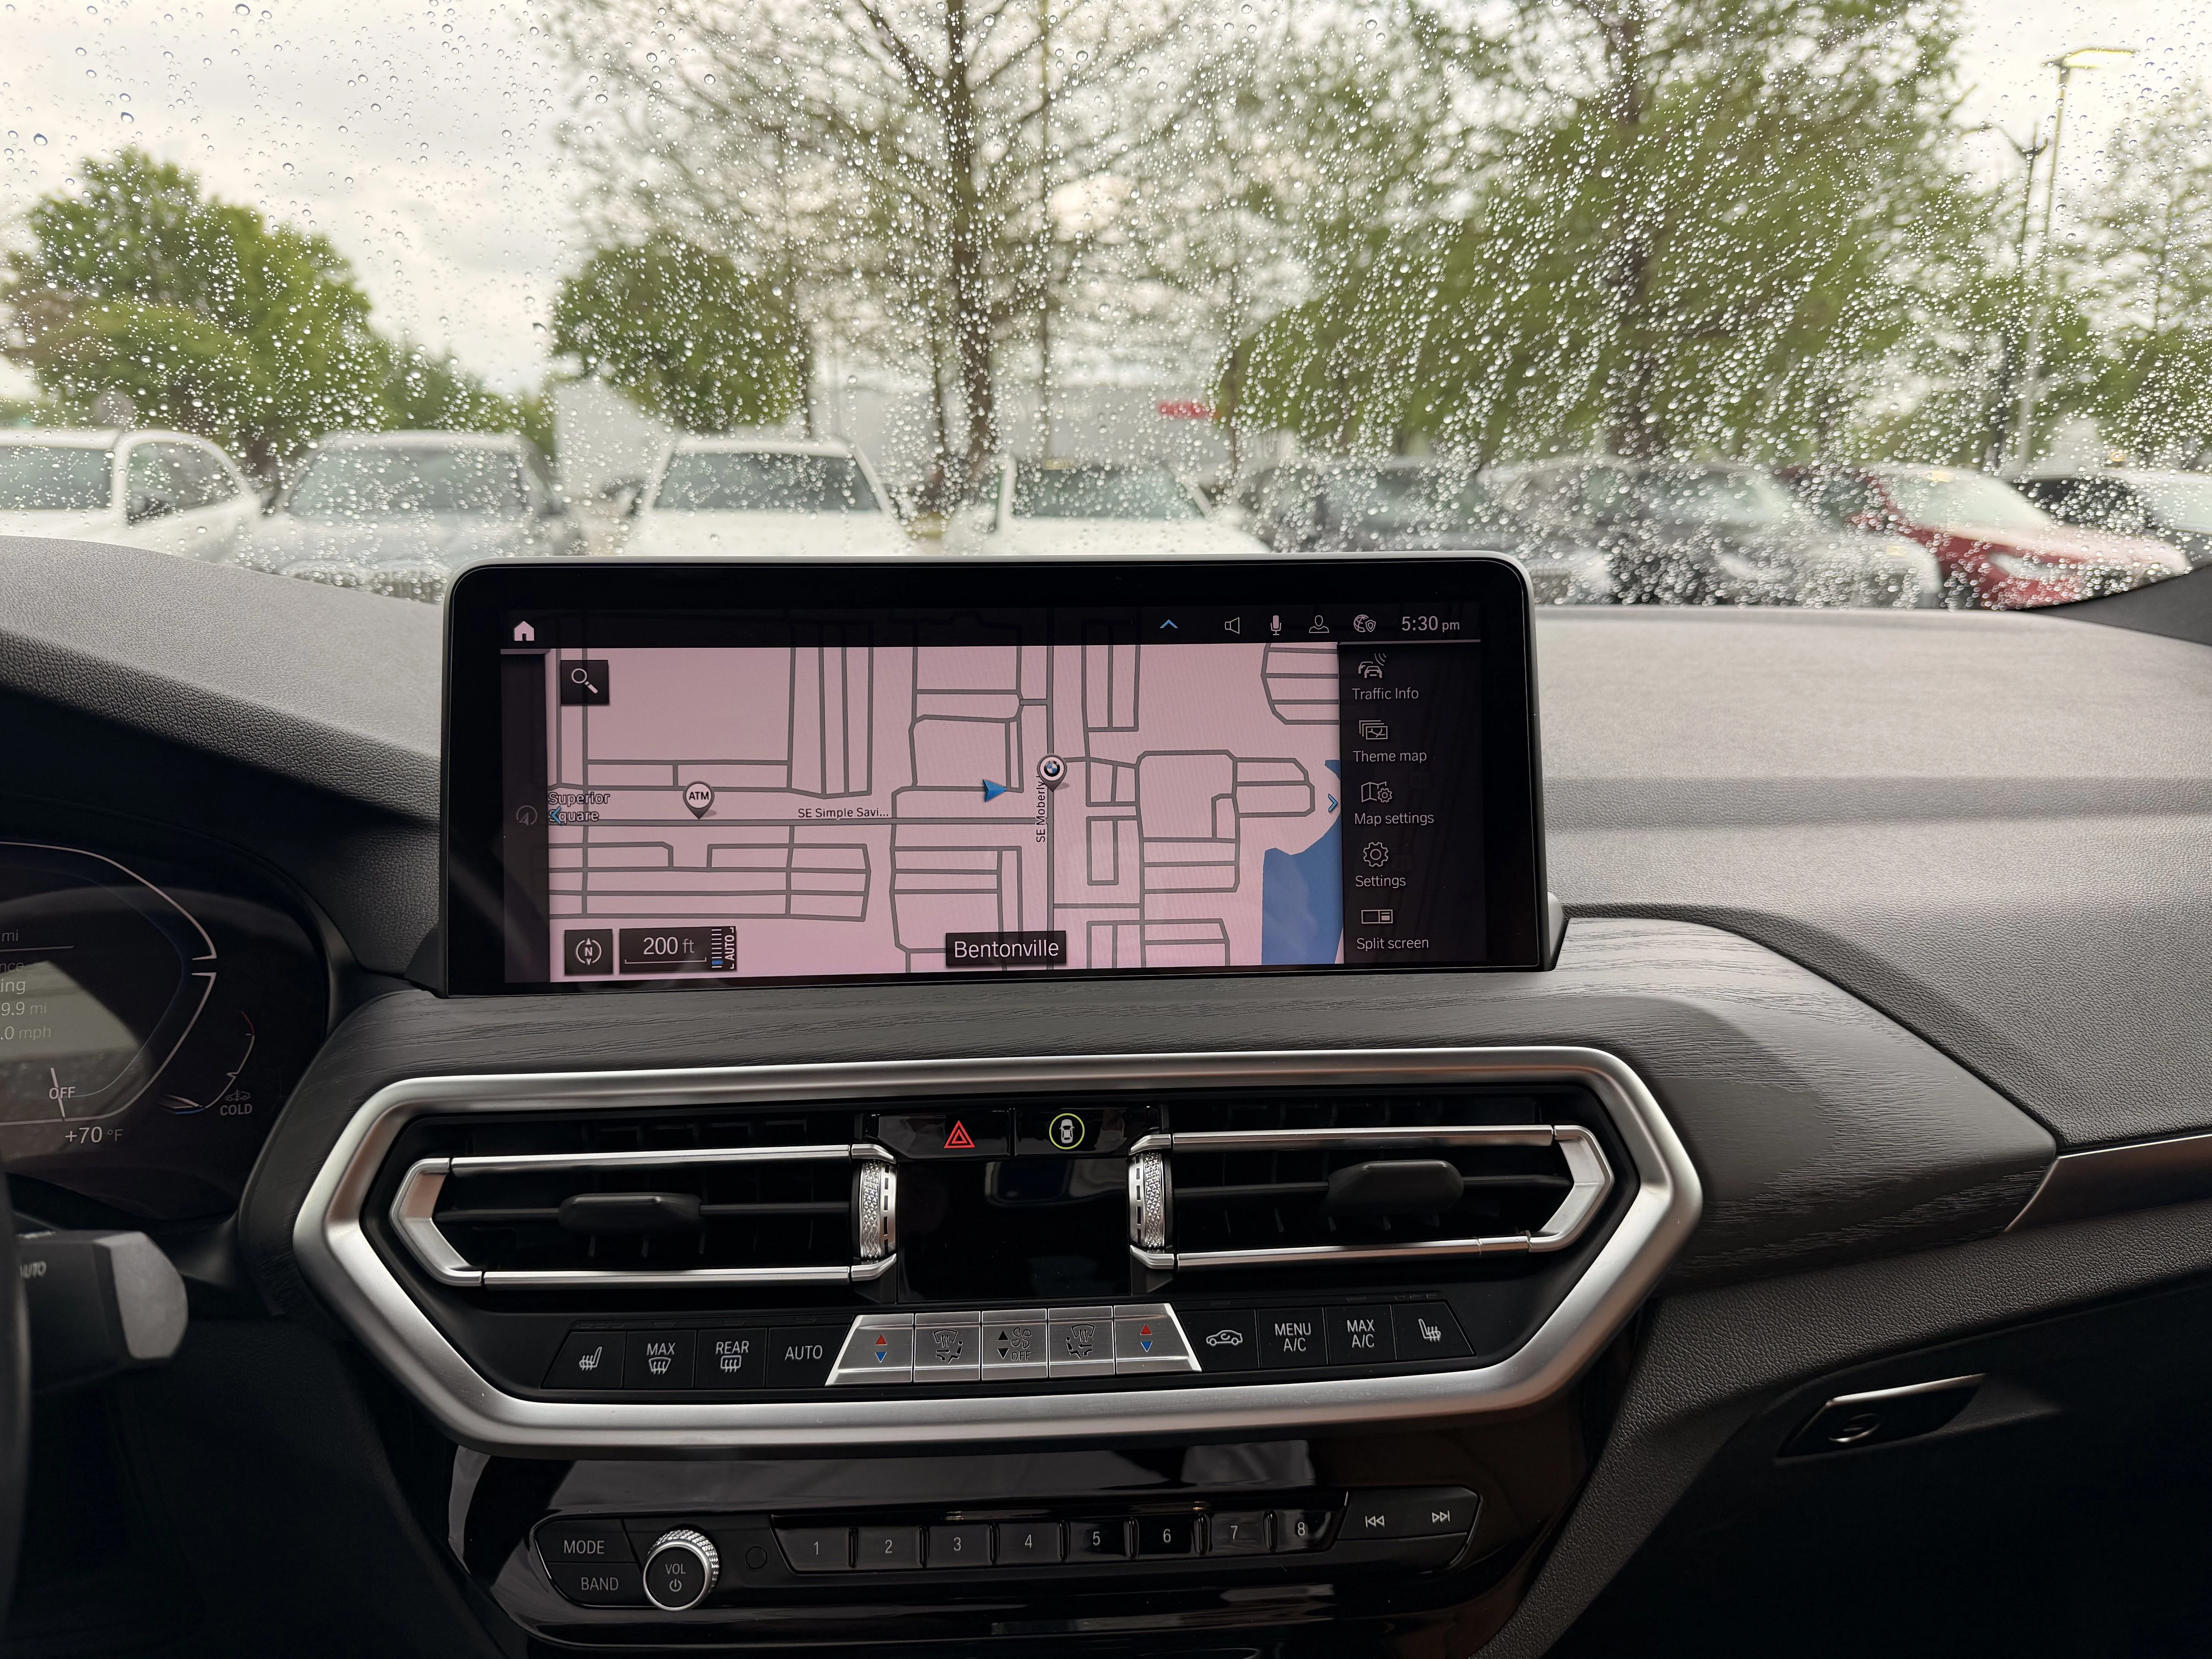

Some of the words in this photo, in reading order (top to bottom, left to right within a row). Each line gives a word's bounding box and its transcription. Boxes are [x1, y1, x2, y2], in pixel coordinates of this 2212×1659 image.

[1402, 616, 1438, 632] 5:30
[1442, 620, 1460, 633] pm
[1352, 687, 1391, 700] Traffic
[1396, 687, 1419, 699] Info
[1353, 750, 1396, 762] Theme
[1400, 751, 1427, 763] map
[548, 792, 610, 807] Superior
[689, 792, 709, 800] ATM
[1036, 781, 1048, 825] Moberly
[798, 808, 812, 817] SE
[815, 808, 853, 820] Simple
[857, 807, 889, 817] Savi...
[1355, 813, 1381, 826] Map
[1385, 812, 1434, 826] settings
[1036, 829, 1046, 843] SE
[1355, 875, 1406, 888] Settings
[2, 929, 19, 942] mi
[585, 947, 592, 956] N
[643, 937, 678, 955] 200
[682, 939, 694, 953] ft
[725, 935, 735, 961] AUTO
[955, 939, 1059, 958] Bentonville
[1357, 938, 1384, 951] Split
[1388, 939, 1429, 949] screen
[30, 1002, 46, 1014] mi
[19, 1026, 51, 1041] mph
[49, 1086, 75, 1100] OFF
[220, 1103, 253, 1116] COLD
[65, 1127, 103, 1144] +70
[1275, 1322, 1311, 1336] MENU
[1347, 1319, 1375, 1333] MAX
[716, 1341, 749, 1355] REAR
[1284, 1337, 1306, 1352] A/C
[1352, 1334, 1375, 1348] A/C
[647, 1343, 676, 1355] MAX
[785, 1345, 823, 1360] AUTO
[1011, 1351, 1031, 1361] OFF
[1163, 1528, 1171, 1544] 6
[1231, 1525, 1238, 1540] 7
[1297, 1522, 1305, 1537] 8
[953, 1537, 962, 1551] 3
[1024, 1534, 1033, 1549] 4
[1092, 1532, 1101, 1546] 5
[564, 1540, 605, 1554] MODE
[814, 1541, 819, 1555] 1
[885, 1539, 893, 1554] 2
[666, 1563, 686, 1575] VOL
[581, 1577, 619, 1591] BAND
